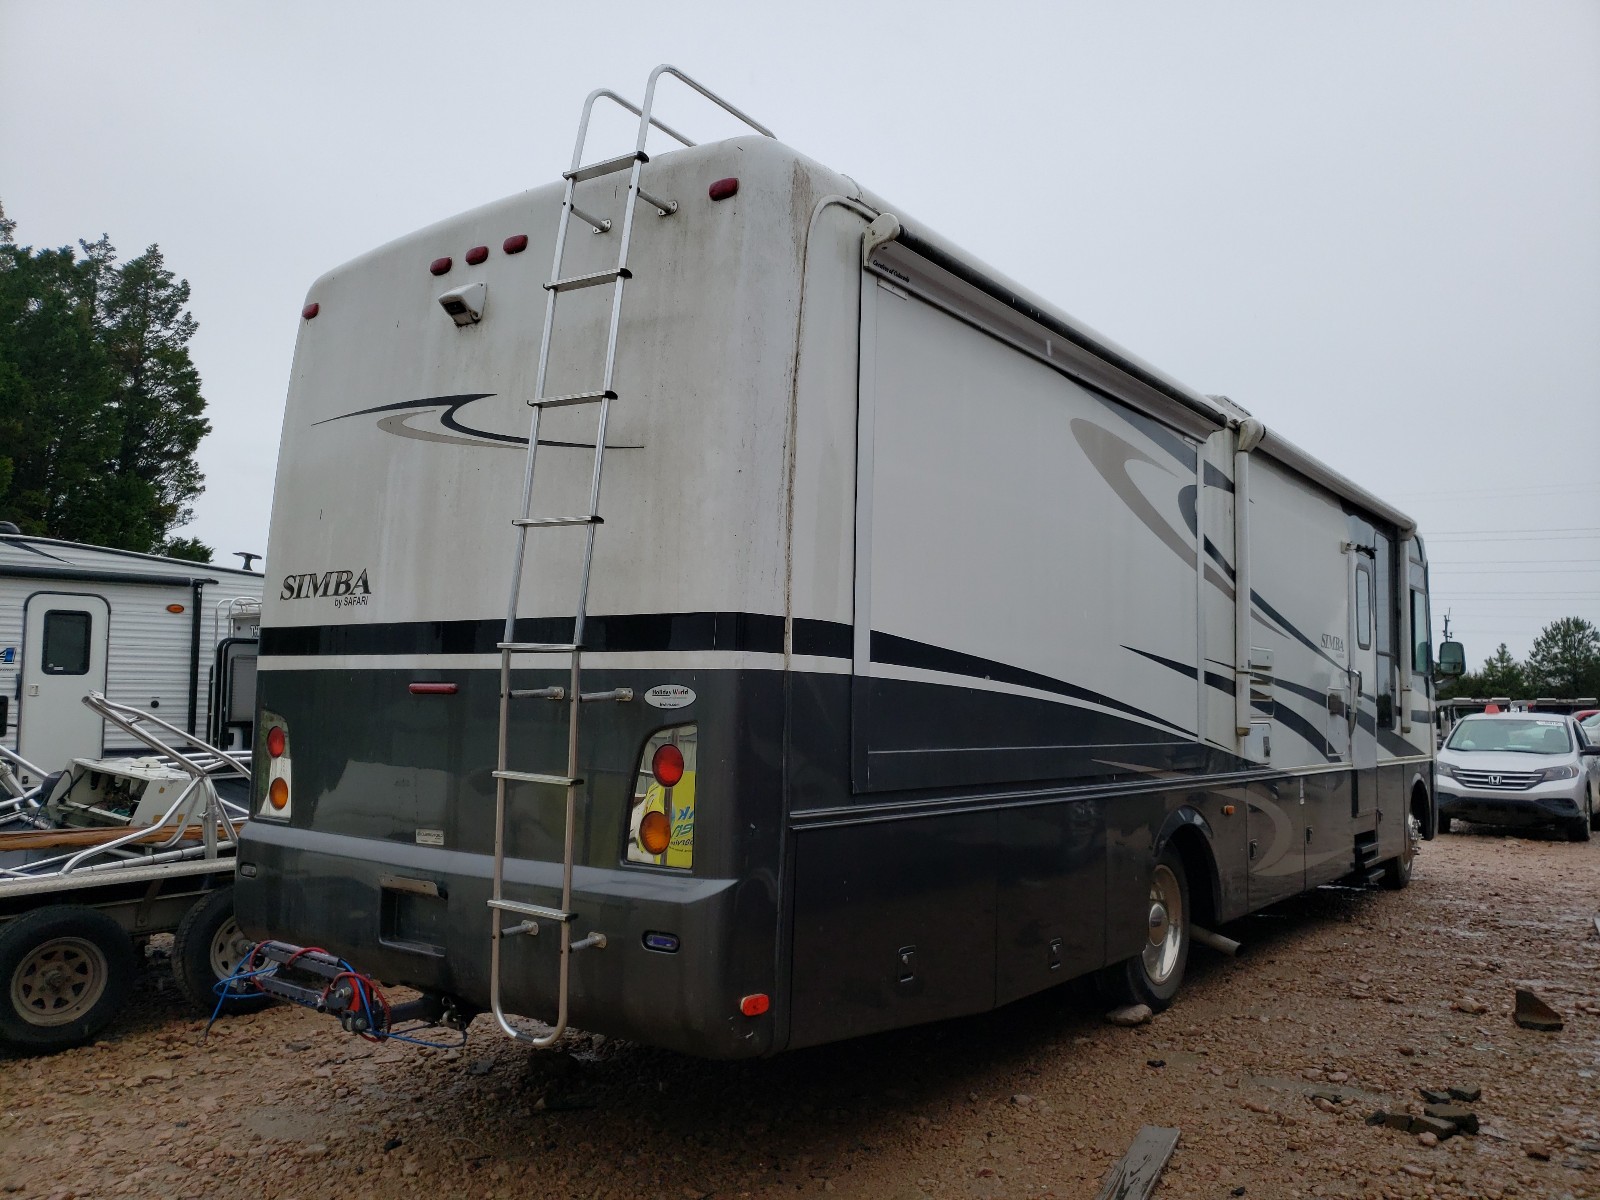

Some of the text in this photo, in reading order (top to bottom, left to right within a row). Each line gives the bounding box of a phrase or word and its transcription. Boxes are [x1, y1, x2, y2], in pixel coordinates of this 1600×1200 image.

[280, 568, 371, 601] SIMBA
[335, 596, 368, 608] by SAFARI
[1321, 633, 1344, 652] SIMBA
